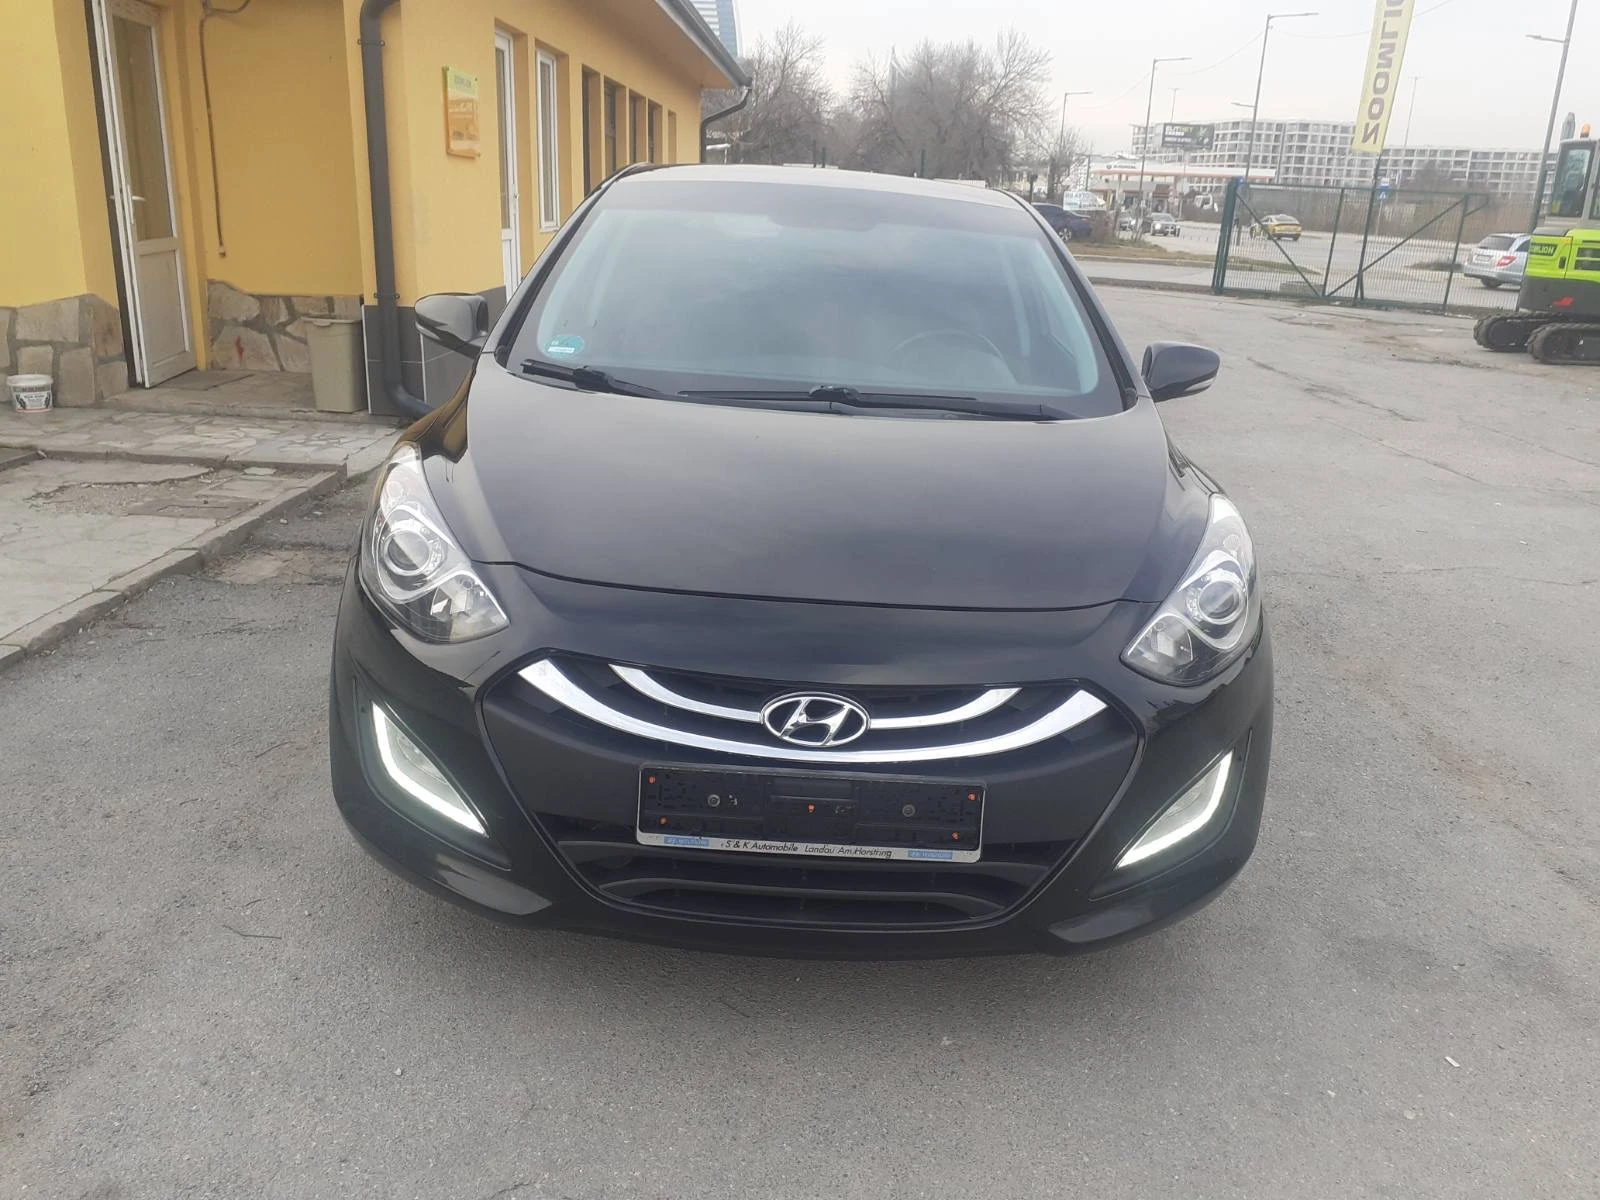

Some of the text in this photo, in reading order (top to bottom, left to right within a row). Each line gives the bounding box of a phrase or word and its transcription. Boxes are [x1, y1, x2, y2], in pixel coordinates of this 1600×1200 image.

[725, 839, 732, 848] S
[733, 839, 741, 849] &
[743, 841, 750, 849] K
[751, 841, 799, 853] Automobile
